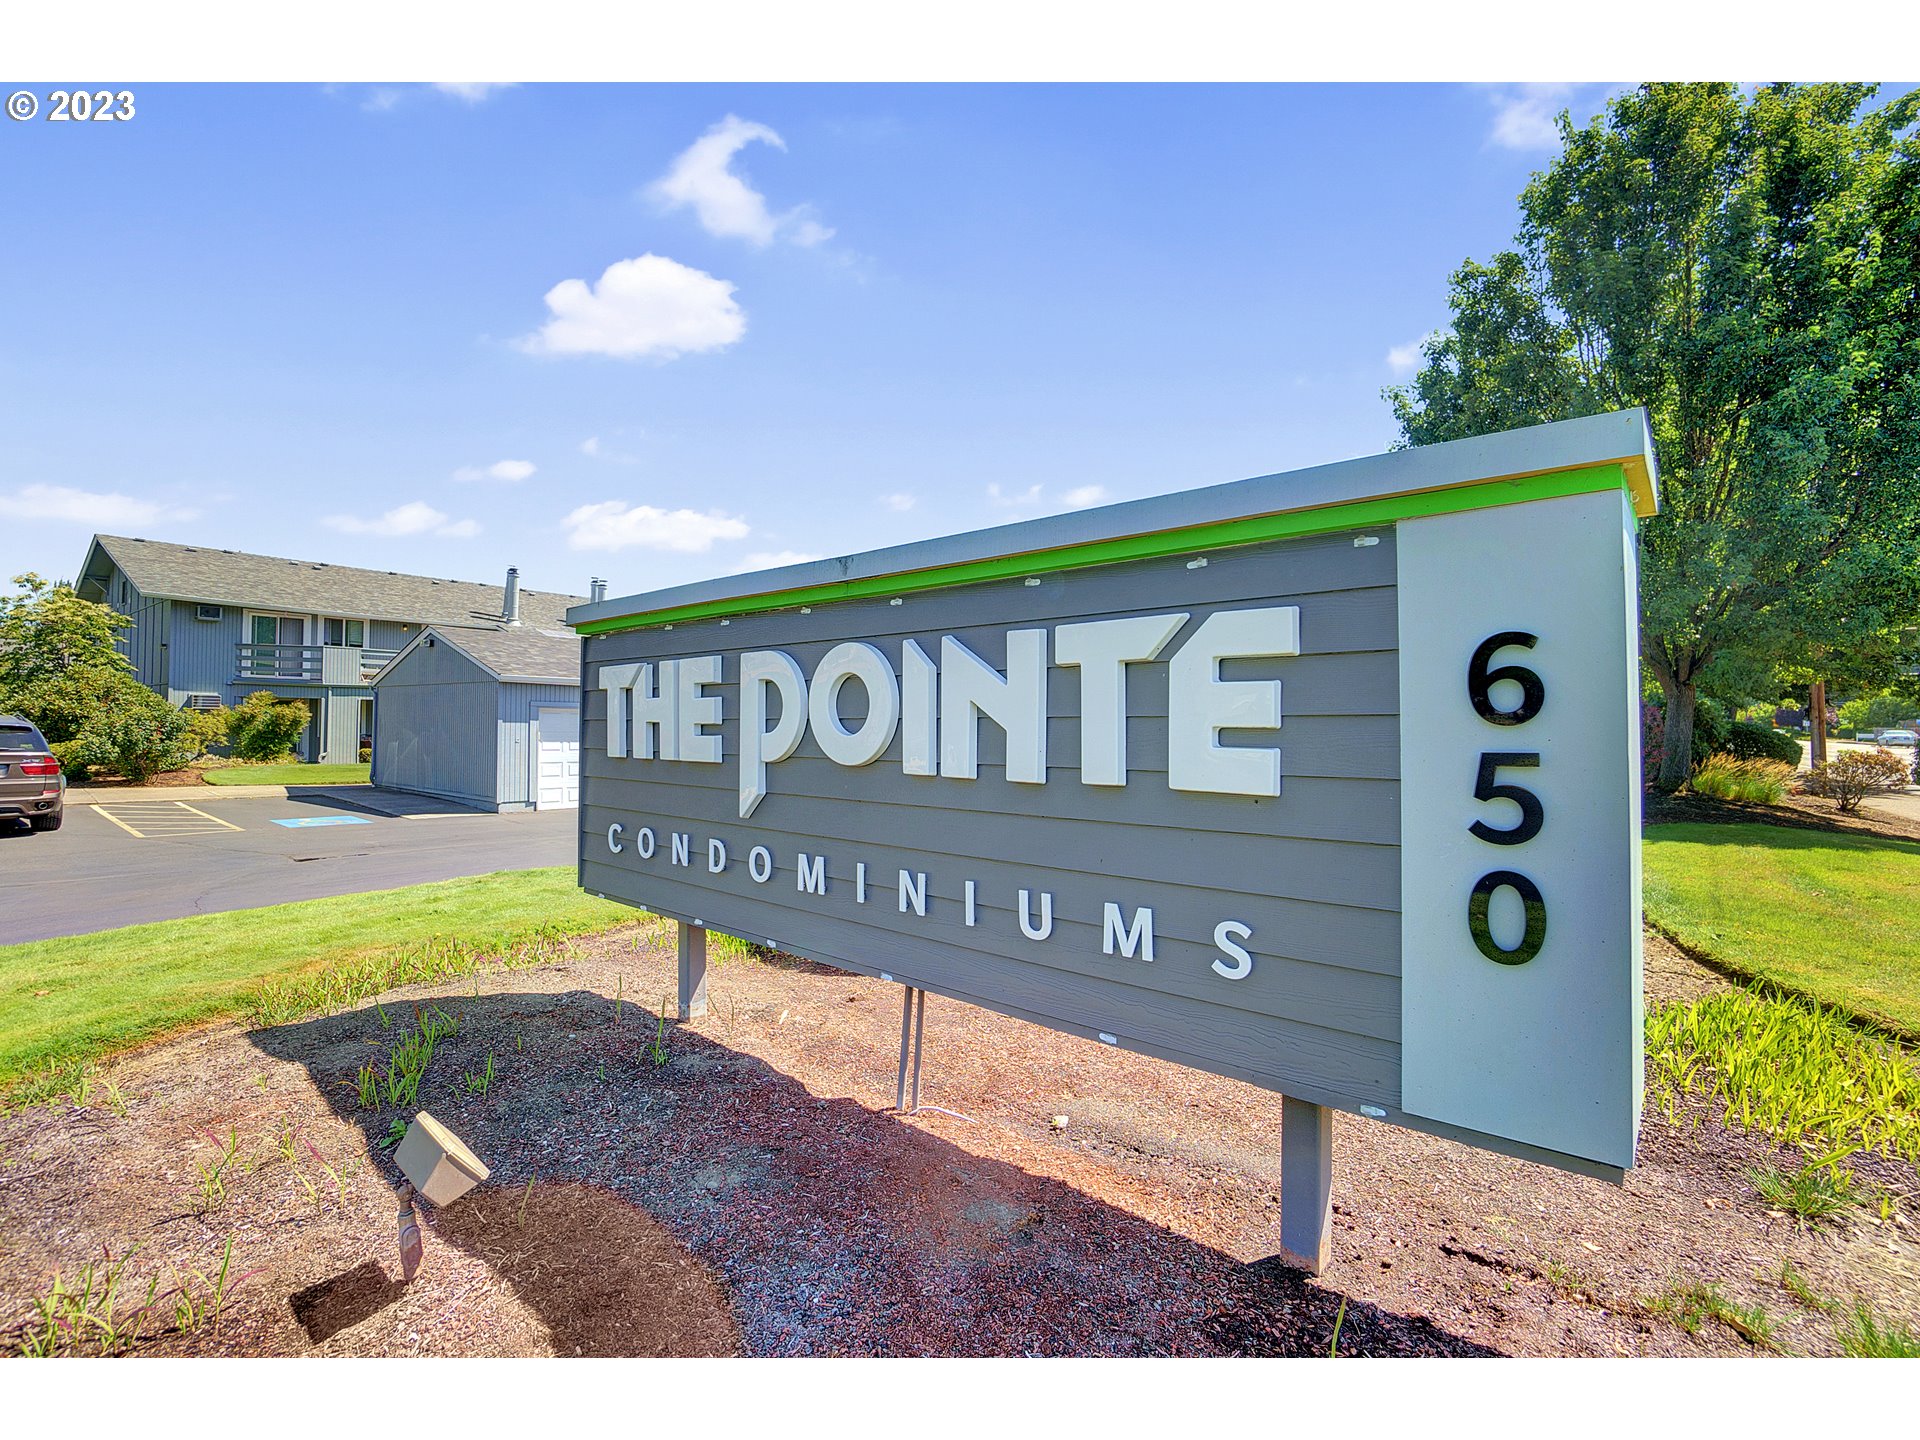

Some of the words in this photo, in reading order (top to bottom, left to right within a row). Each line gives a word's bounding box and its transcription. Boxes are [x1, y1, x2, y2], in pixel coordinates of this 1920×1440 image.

[598, 654, 723, 763] THE
[739, 605, 1301, 819] POINTE
[1467, 630, 1547, 966] 650
[606, 822, 1255, 981] CONDOMINIUMS
